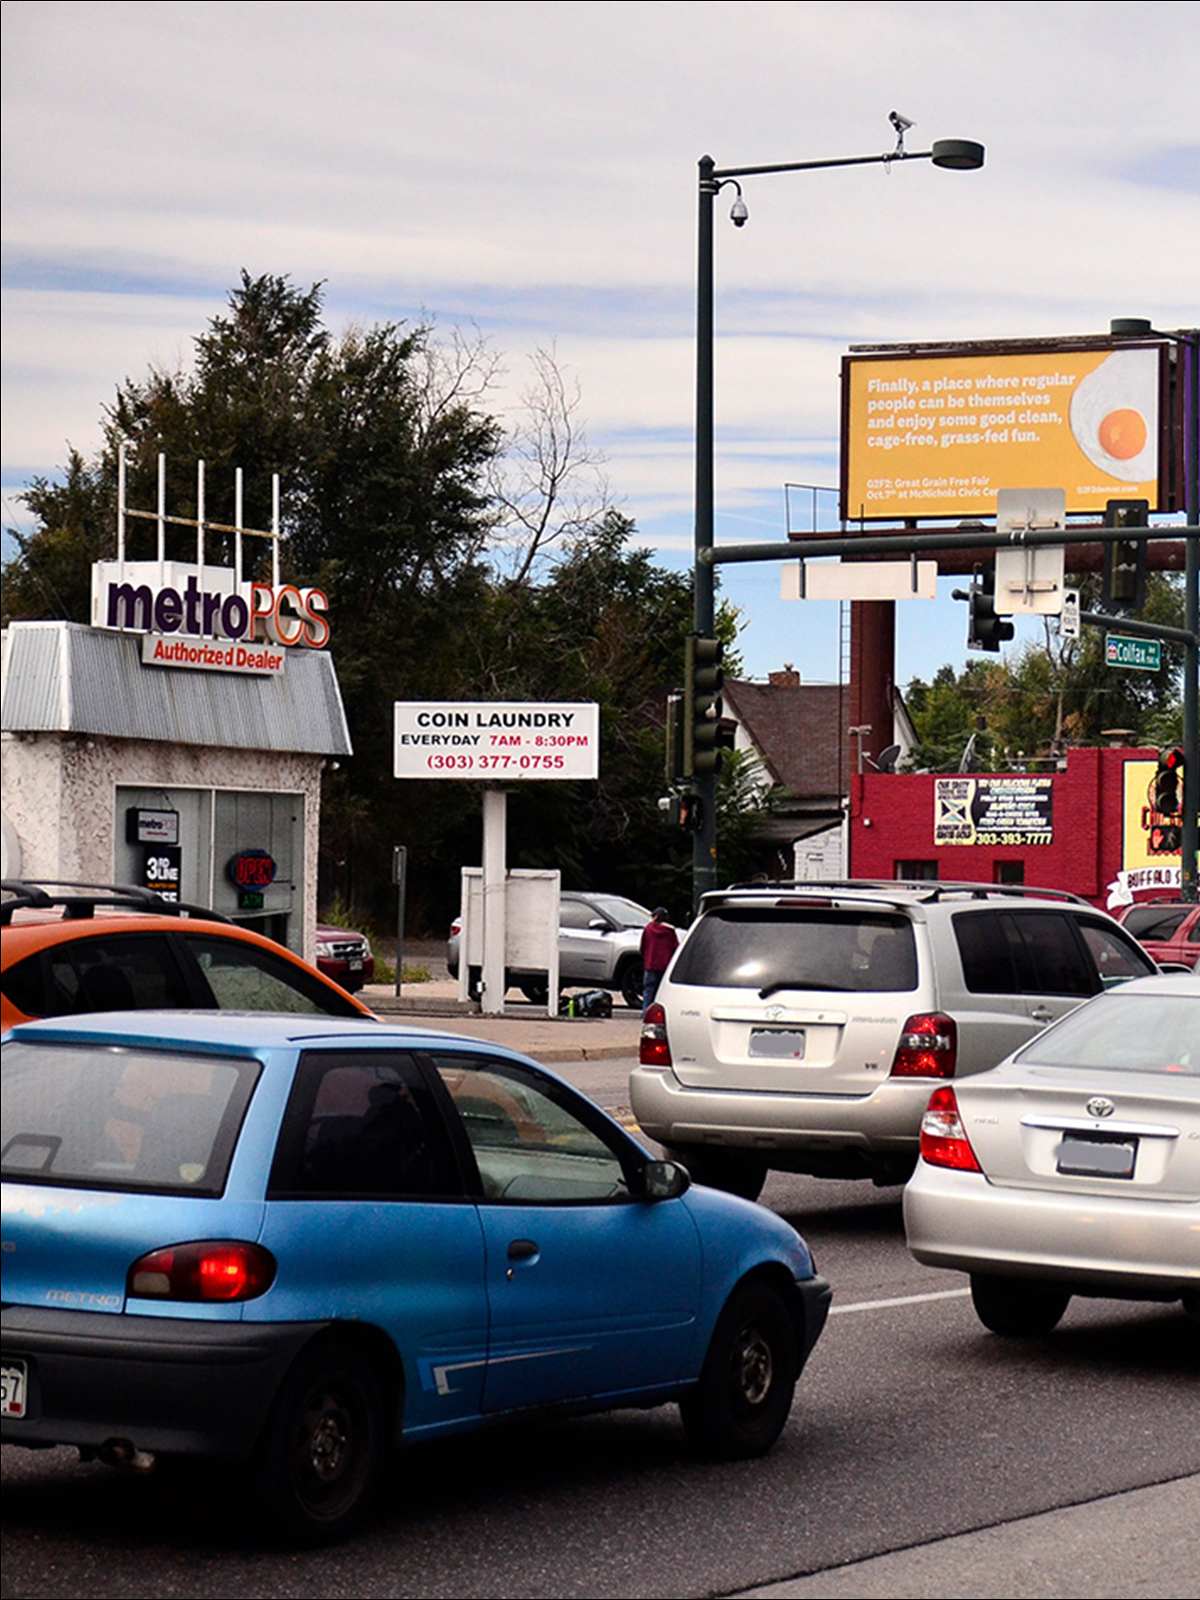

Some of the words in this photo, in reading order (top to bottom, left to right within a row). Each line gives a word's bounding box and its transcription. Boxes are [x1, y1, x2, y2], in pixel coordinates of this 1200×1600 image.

[868, 378, 920, 393] Finally,
[922, 381, 930, 391] a
[934, 376, 973, 393] place
[975, 375, 1019, 388] where
[1022, 372, 1076, 389] regular
[868, 396, 915, 414] people
[918, 398, 944, 409] can
[948, 395, 964, 408] be
[968, 392, 1050, 407] themselves
[868, 414, 894, 428] and
[897, 414, 936, 430] enjoy
[939, 414, 977, 426] some
[980, 411, 1016, 428] good
[1018, 410, 1062, 425] clean,
[868, 433, 938, 450] cage-free,
[941, 428, 1008, 448] grass-fed
[1011, 428, 1040, 442] fun.
[895, 478, 920, 488] Great
[922, 477, 948, 486] Grain
[950, 477, 970, 486] Free
[972, 476, 990, 485] Fair
[898, 490, 908, 498] at
[910, 488, 957, 498] McNichols
[958, 488, 981, 497] Civic
[107, 576, 330, 648] metroPCS
[154, 640, 234, 666] Authorized
[236, 648, 282, 670] Dealer
[1118, 643, 1146, 664] Colfax
[417, 713, 468, 728] COIN
[476, 713, 574, 728] LAUNDRY
[401, 734, 480, 746] EVERYDAY
[490, 735, 522, 746] 7AM
[534, 736, 588, 746] 8:30PM
[427, 755, 474, 769] (303)
[478, 755, 564, 769] 377-0755
[976, 832, 1052, 845] 303-393-7777
[235, 857, 272, 884] OPEN
[1128, 870, 1171, 889] BUFFALO
[242, 894, 262, 906] ATM
[864, 1062, 878, 1070] V6
[46, 1289, 122, 1306] METRO
